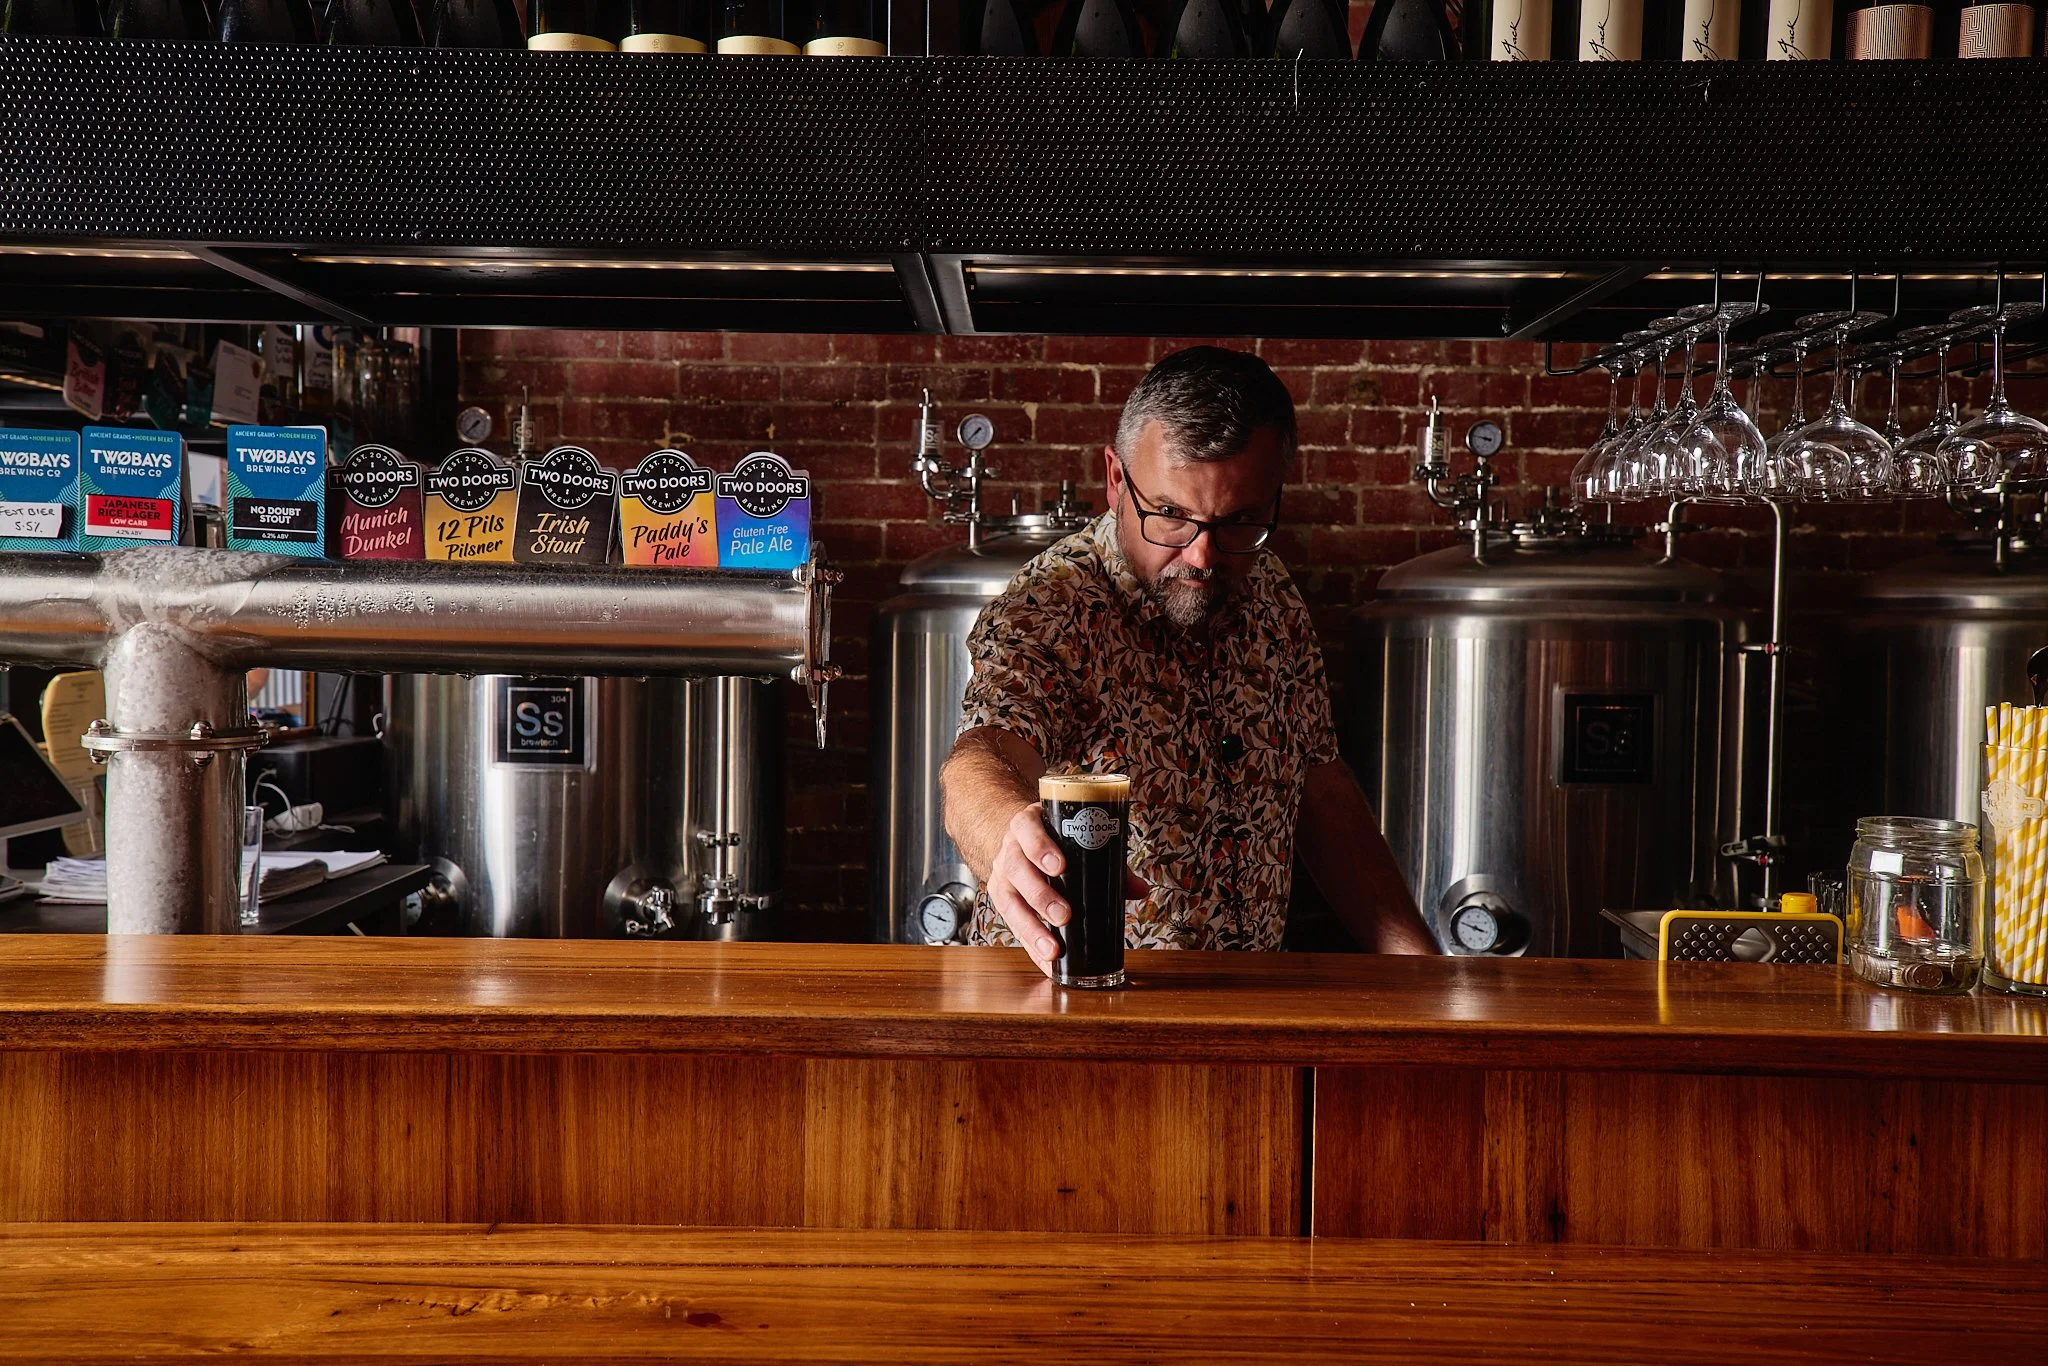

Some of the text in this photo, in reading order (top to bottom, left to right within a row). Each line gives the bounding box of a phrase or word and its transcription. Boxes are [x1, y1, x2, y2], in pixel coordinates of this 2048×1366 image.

[369, 452, 393, 466] 2020
[465, 456, 488, 469] 2020
[570, 454, 592, 471] 2020
[662, 458, 686, 472] 2020
[100, 466, 146, 477] BREWING
[246, 464, 291, 474] BREWING
[760, 462, 784, 477] 2020
[333, 470, 413, 484] TWO DOORS
[428, 473, 509, 489] TWO DOORS
[530, 469, 609, 490] TWO DOORS
[626, 475, 706, 491] TWO DOORS
[353, 487, 394, 503] BREWING
[722, 481, 803, 494] TWO DOORS
[449, 490, 490, 506] BREWING
[549, 487, 588, 505] BREWING
[647, 493, 687, 508] BREWING
[28, 508, 55, 516] BIER
[103, 499, 157, 510] JAPANESE
[250, 506, 301, 517] NO DOUBT
[742, 498, 783, 513] BREWING
[98, 508, 161, 520] RICE LAGER
[260, 515, 292, 524] STOUT
[340, 507, 408, 535] Munich
[128, 519, 148, 527] CARB
[438, 514, 505, 542] 12 Pils
[529, 512, 591, 535] Irish
[631, 517, 708, 548] Paddy's
[733, 524, 789, 538] Gluten Free
[345, 527, 412, 556] Dunkel
[530, 534, 586, 554] Stout
[731, 535, 792, 556] Pale Ale
[445, 540, 503, 560] Pilsner
[651, 542, 690, 564] Pale
[515, 702, 564, 737] Ss
[1089, 824, 1116, 832] DOORS
